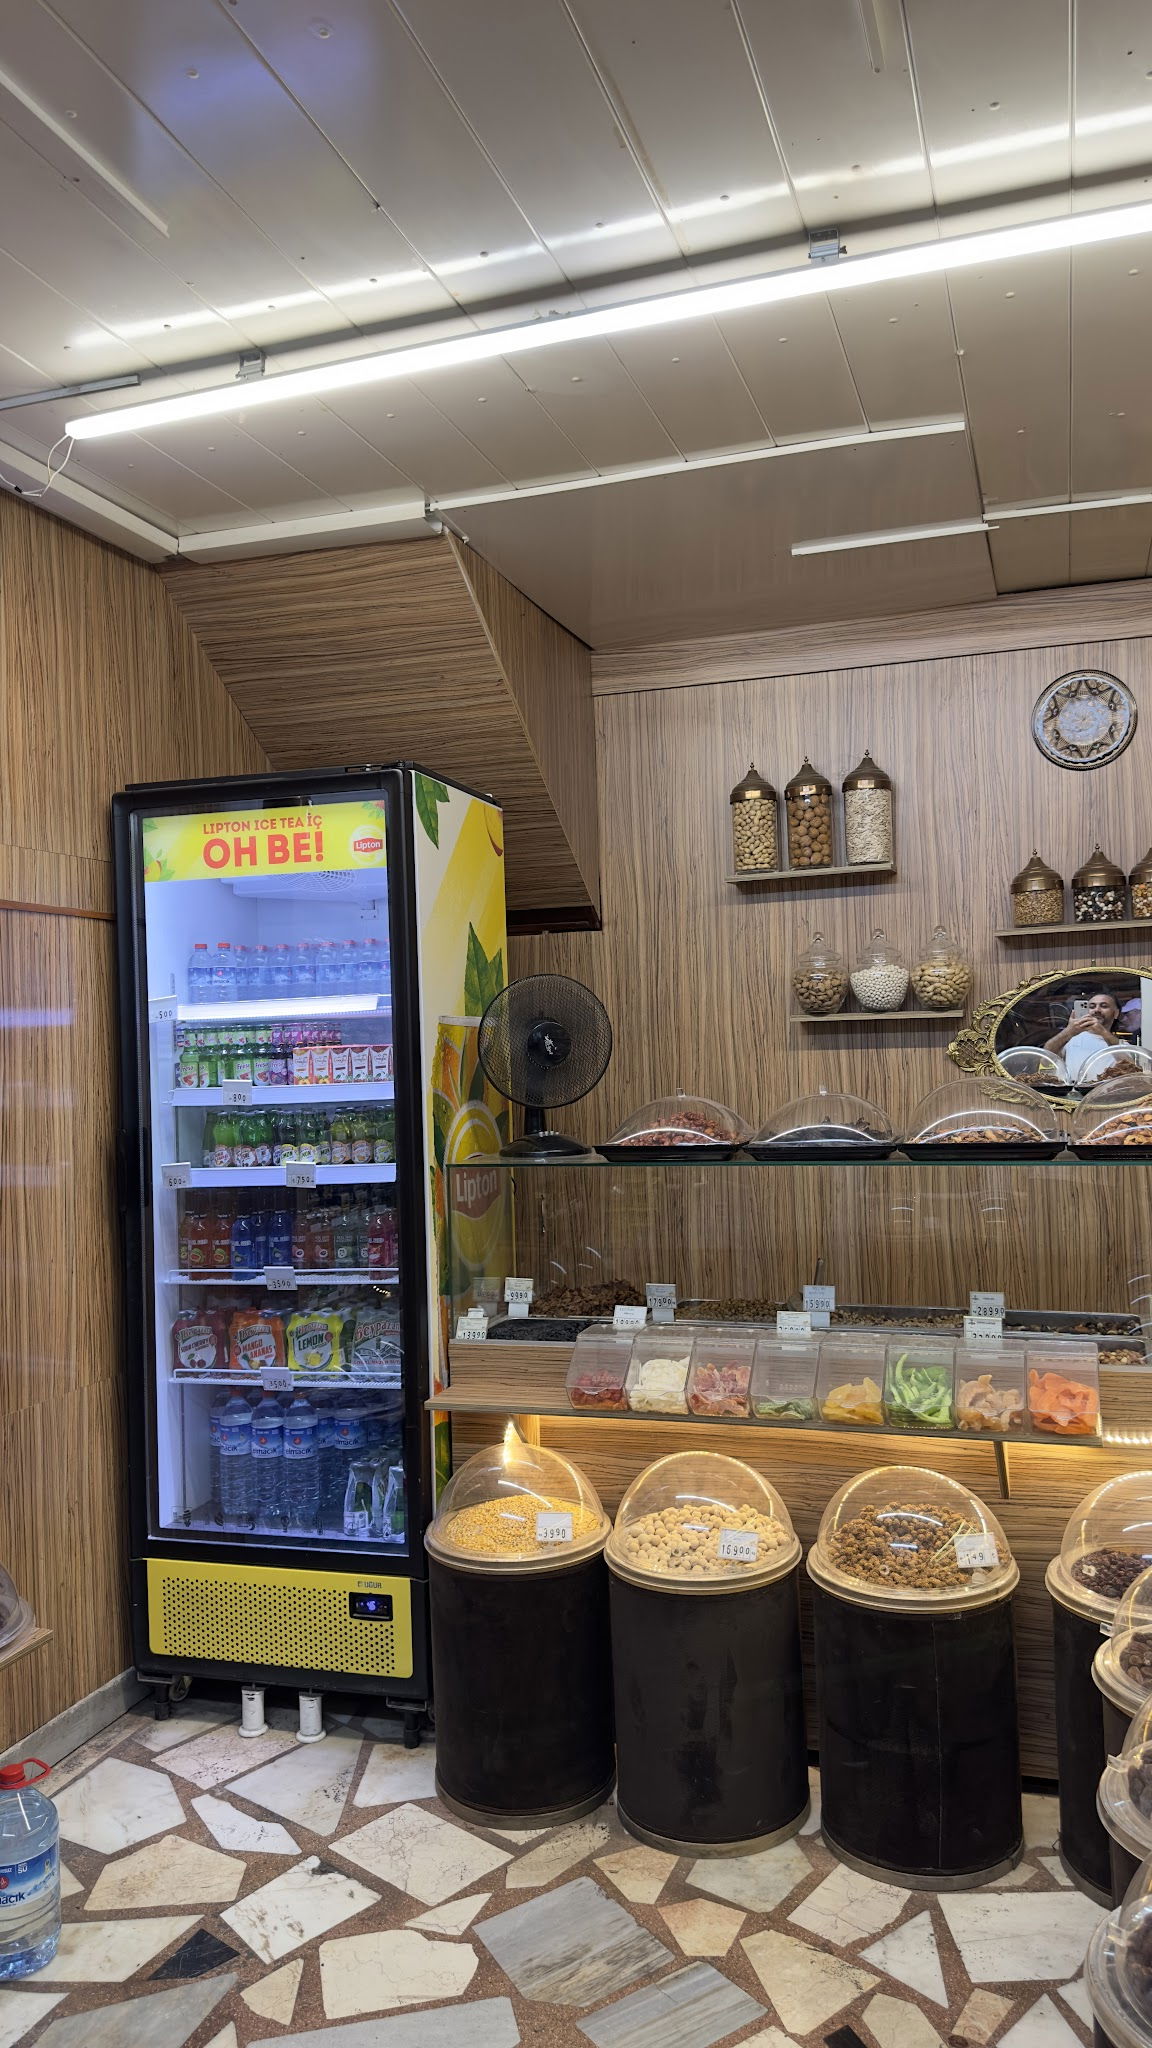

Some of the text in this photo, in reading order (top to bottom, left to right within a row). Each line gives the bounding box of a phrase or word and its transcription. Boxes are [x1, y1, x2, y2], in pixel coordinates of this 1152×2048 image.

[203, 812, 322, 835] LIPTON ICE TEA İÇ
[203, 831, 324, 869] OH BE!
[356, 841, 381, 850] Lipton
[456, 1170, 498, 1209] Lipton
[298, 1332, 325, 1351] LEMON
[543, 1528, 567, 1539] 3990
[722, 1544, 750, 1556] 16900
